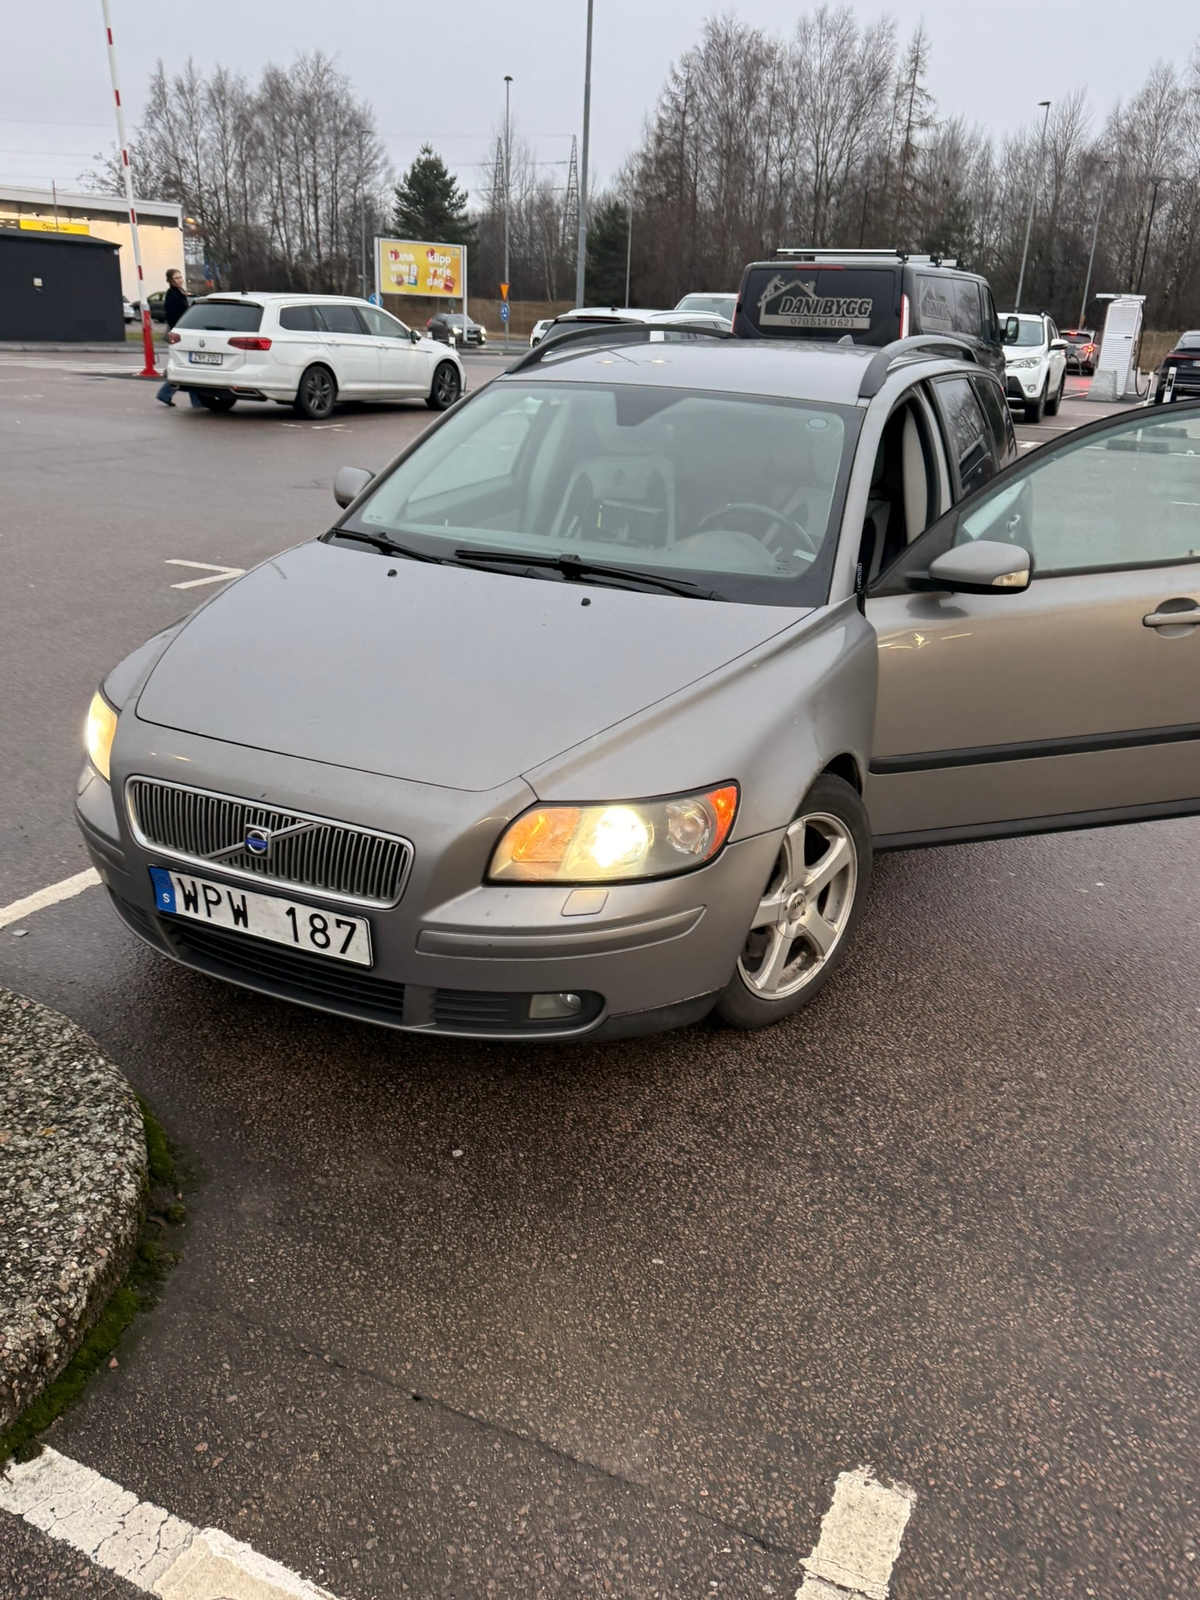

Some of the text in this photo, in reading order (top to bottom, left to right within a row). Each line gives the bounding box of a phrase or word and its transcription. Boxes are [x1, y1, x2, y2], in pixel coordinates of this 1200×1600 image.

[428, 252, 451, 266] klipp
[163, 892, 170, 903] S
[177, 877, 357, 954] WPW 187
